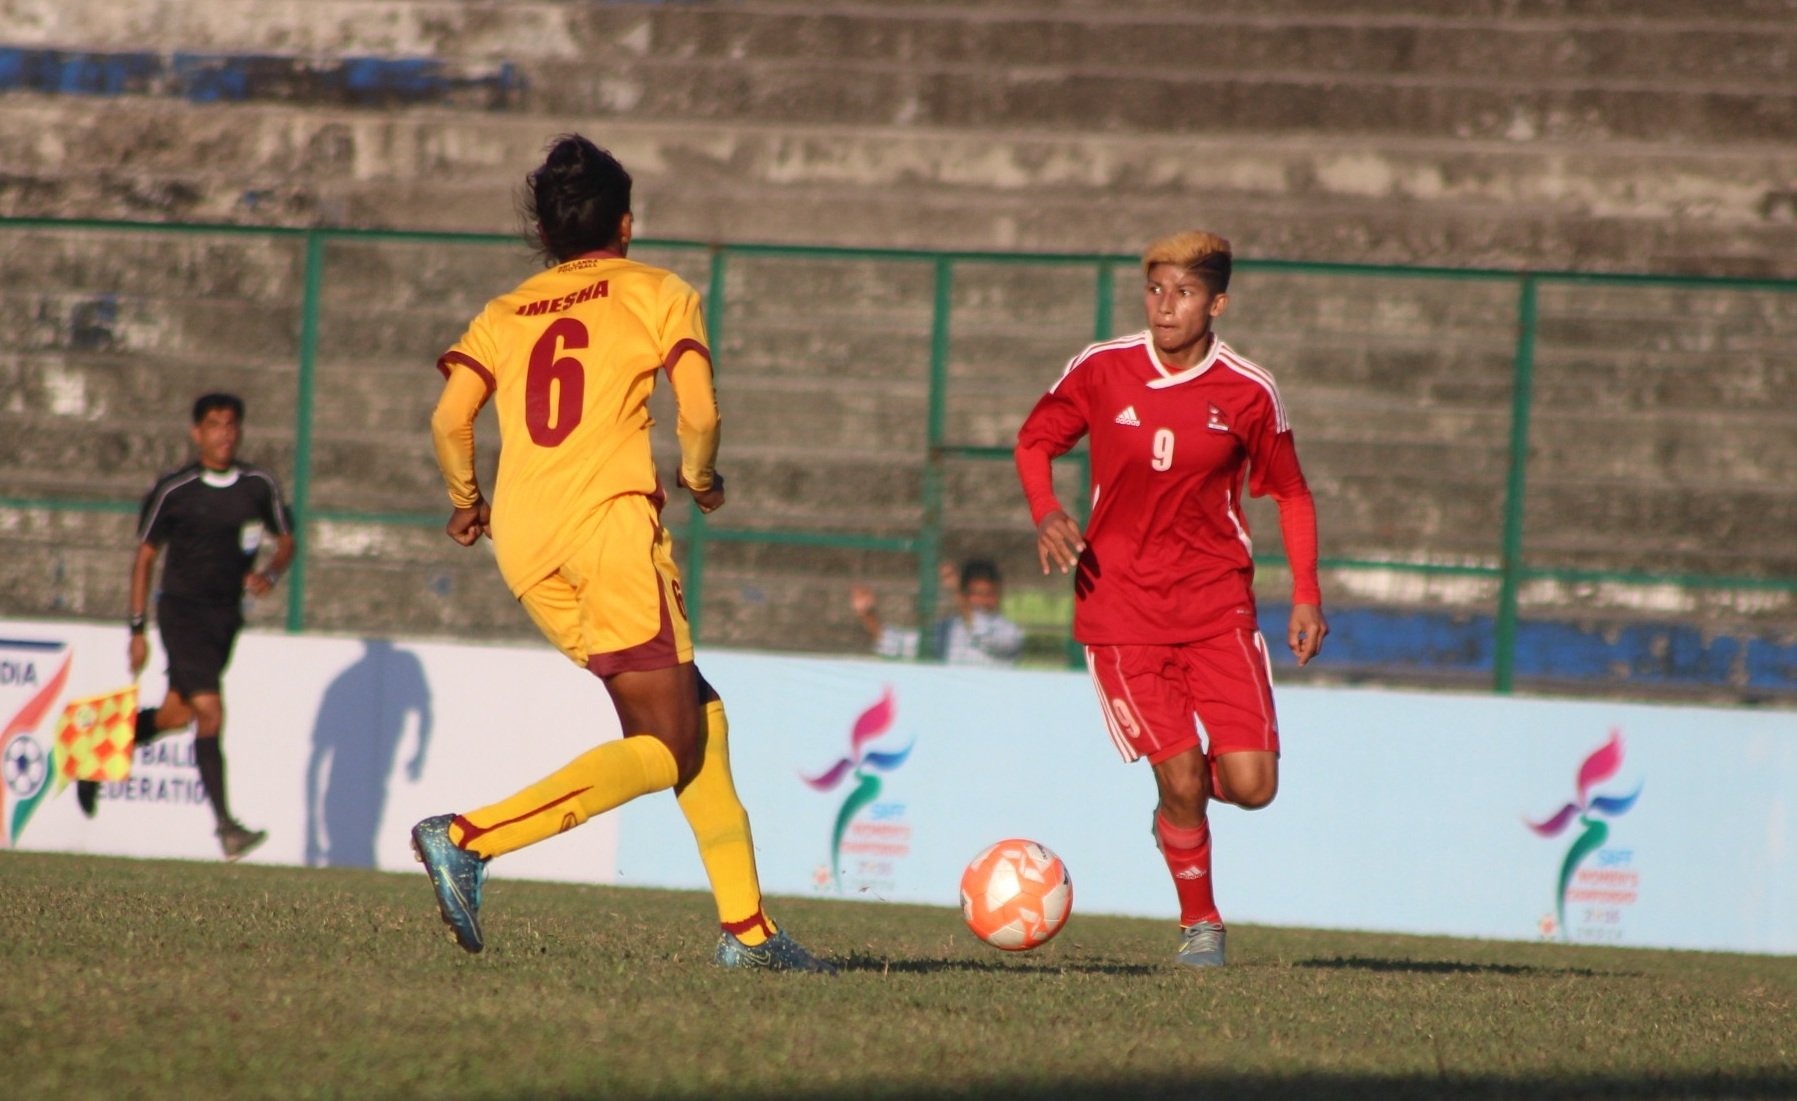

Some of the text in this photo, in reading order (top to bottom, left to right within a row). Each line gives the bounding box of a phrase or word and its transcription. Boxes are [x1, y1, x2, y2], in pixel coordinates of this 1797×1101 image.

[515, 280, 609, 316] IMESHA
[525, 317, 589, 448] 6
[1115, 417, 1140, 427] adidas
[1151, 428, 1174, 472] 9
[671, 579, 687, 621] 6
[0, 662, 37, 684] DIA
[1112, 698, 1140, 738] 9
[97, 776, 208, 804] EDERATIO
